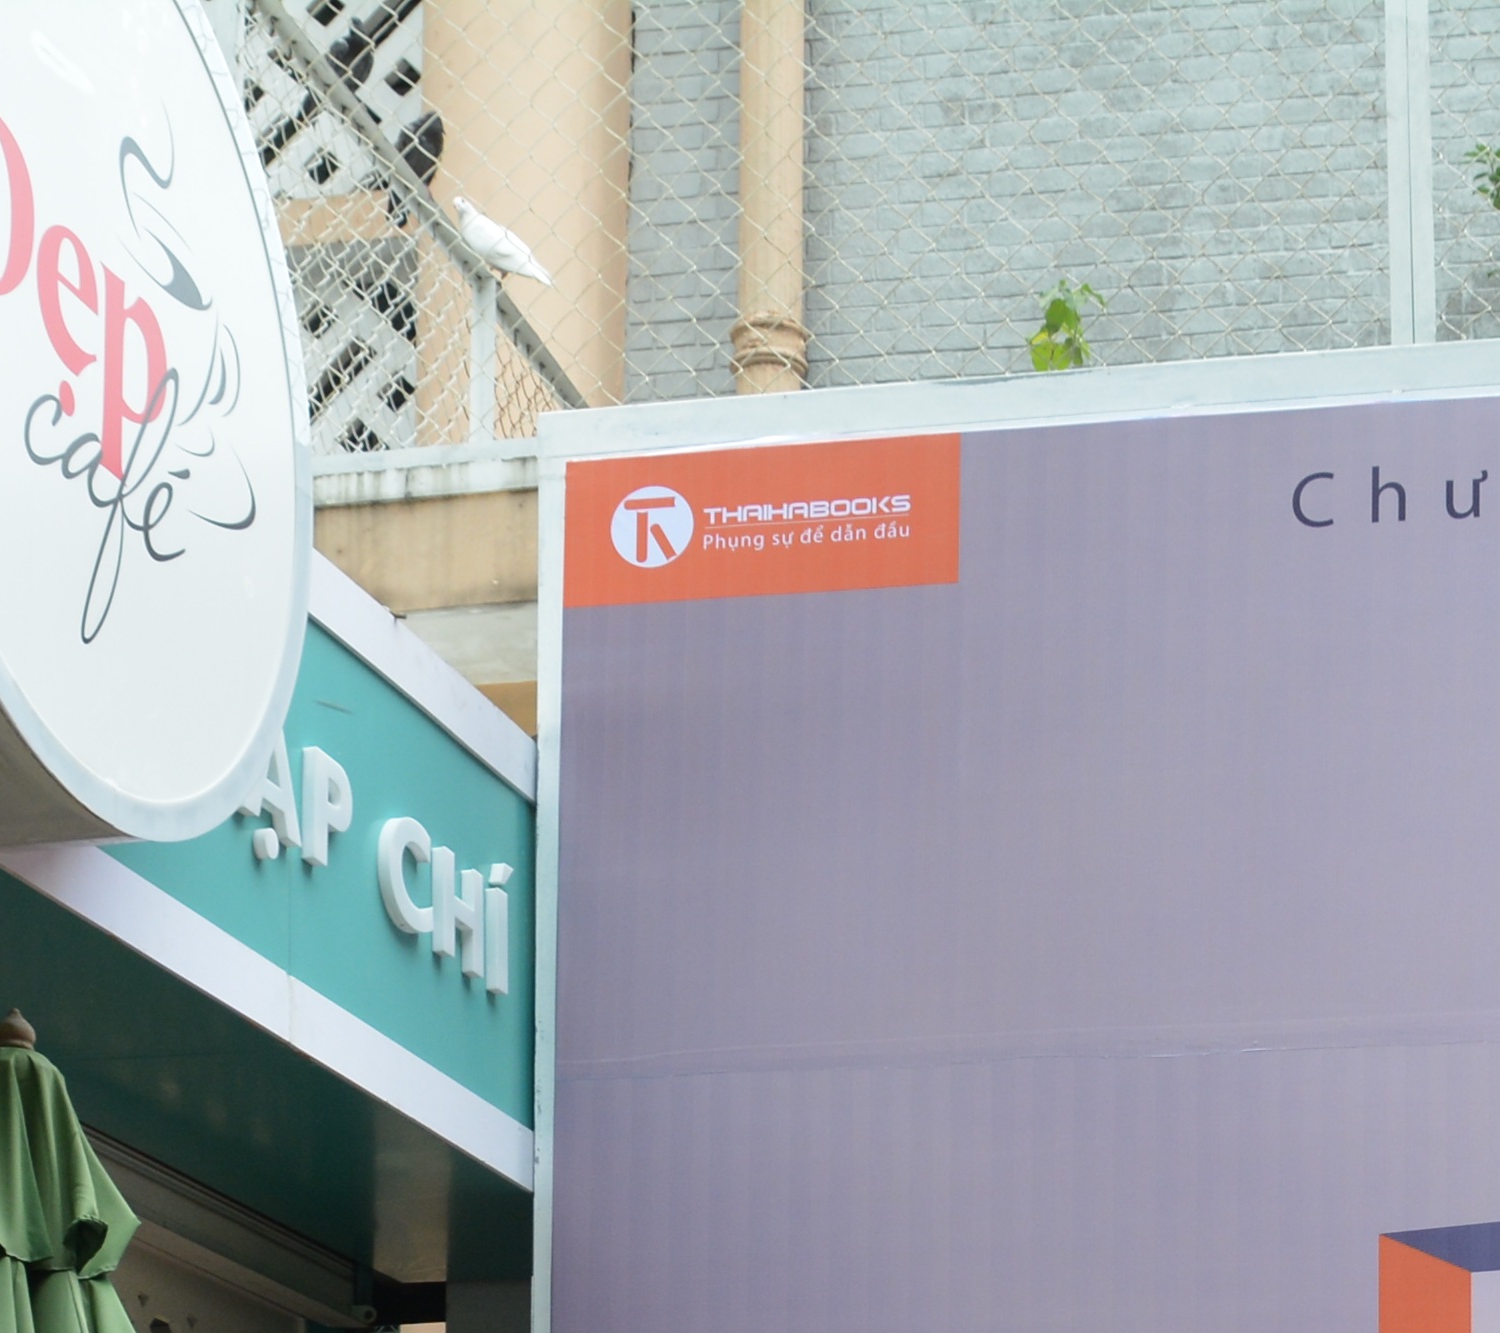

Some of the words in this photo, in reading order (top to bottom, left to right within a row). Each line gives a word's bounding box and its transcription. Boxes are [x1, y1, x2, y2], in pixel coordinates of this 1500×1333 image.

[703, 495, 911, 525] THAIHABOOKS
[703, 533, 765, 551] Phụng
[771, 531, 794, 549] sự
[800, 525, 824, 544] để
[830, 523, 867, 542] dẫn
[873, 520, 910, 539] đầu
[377, 816, 514, 995] CHÍ
